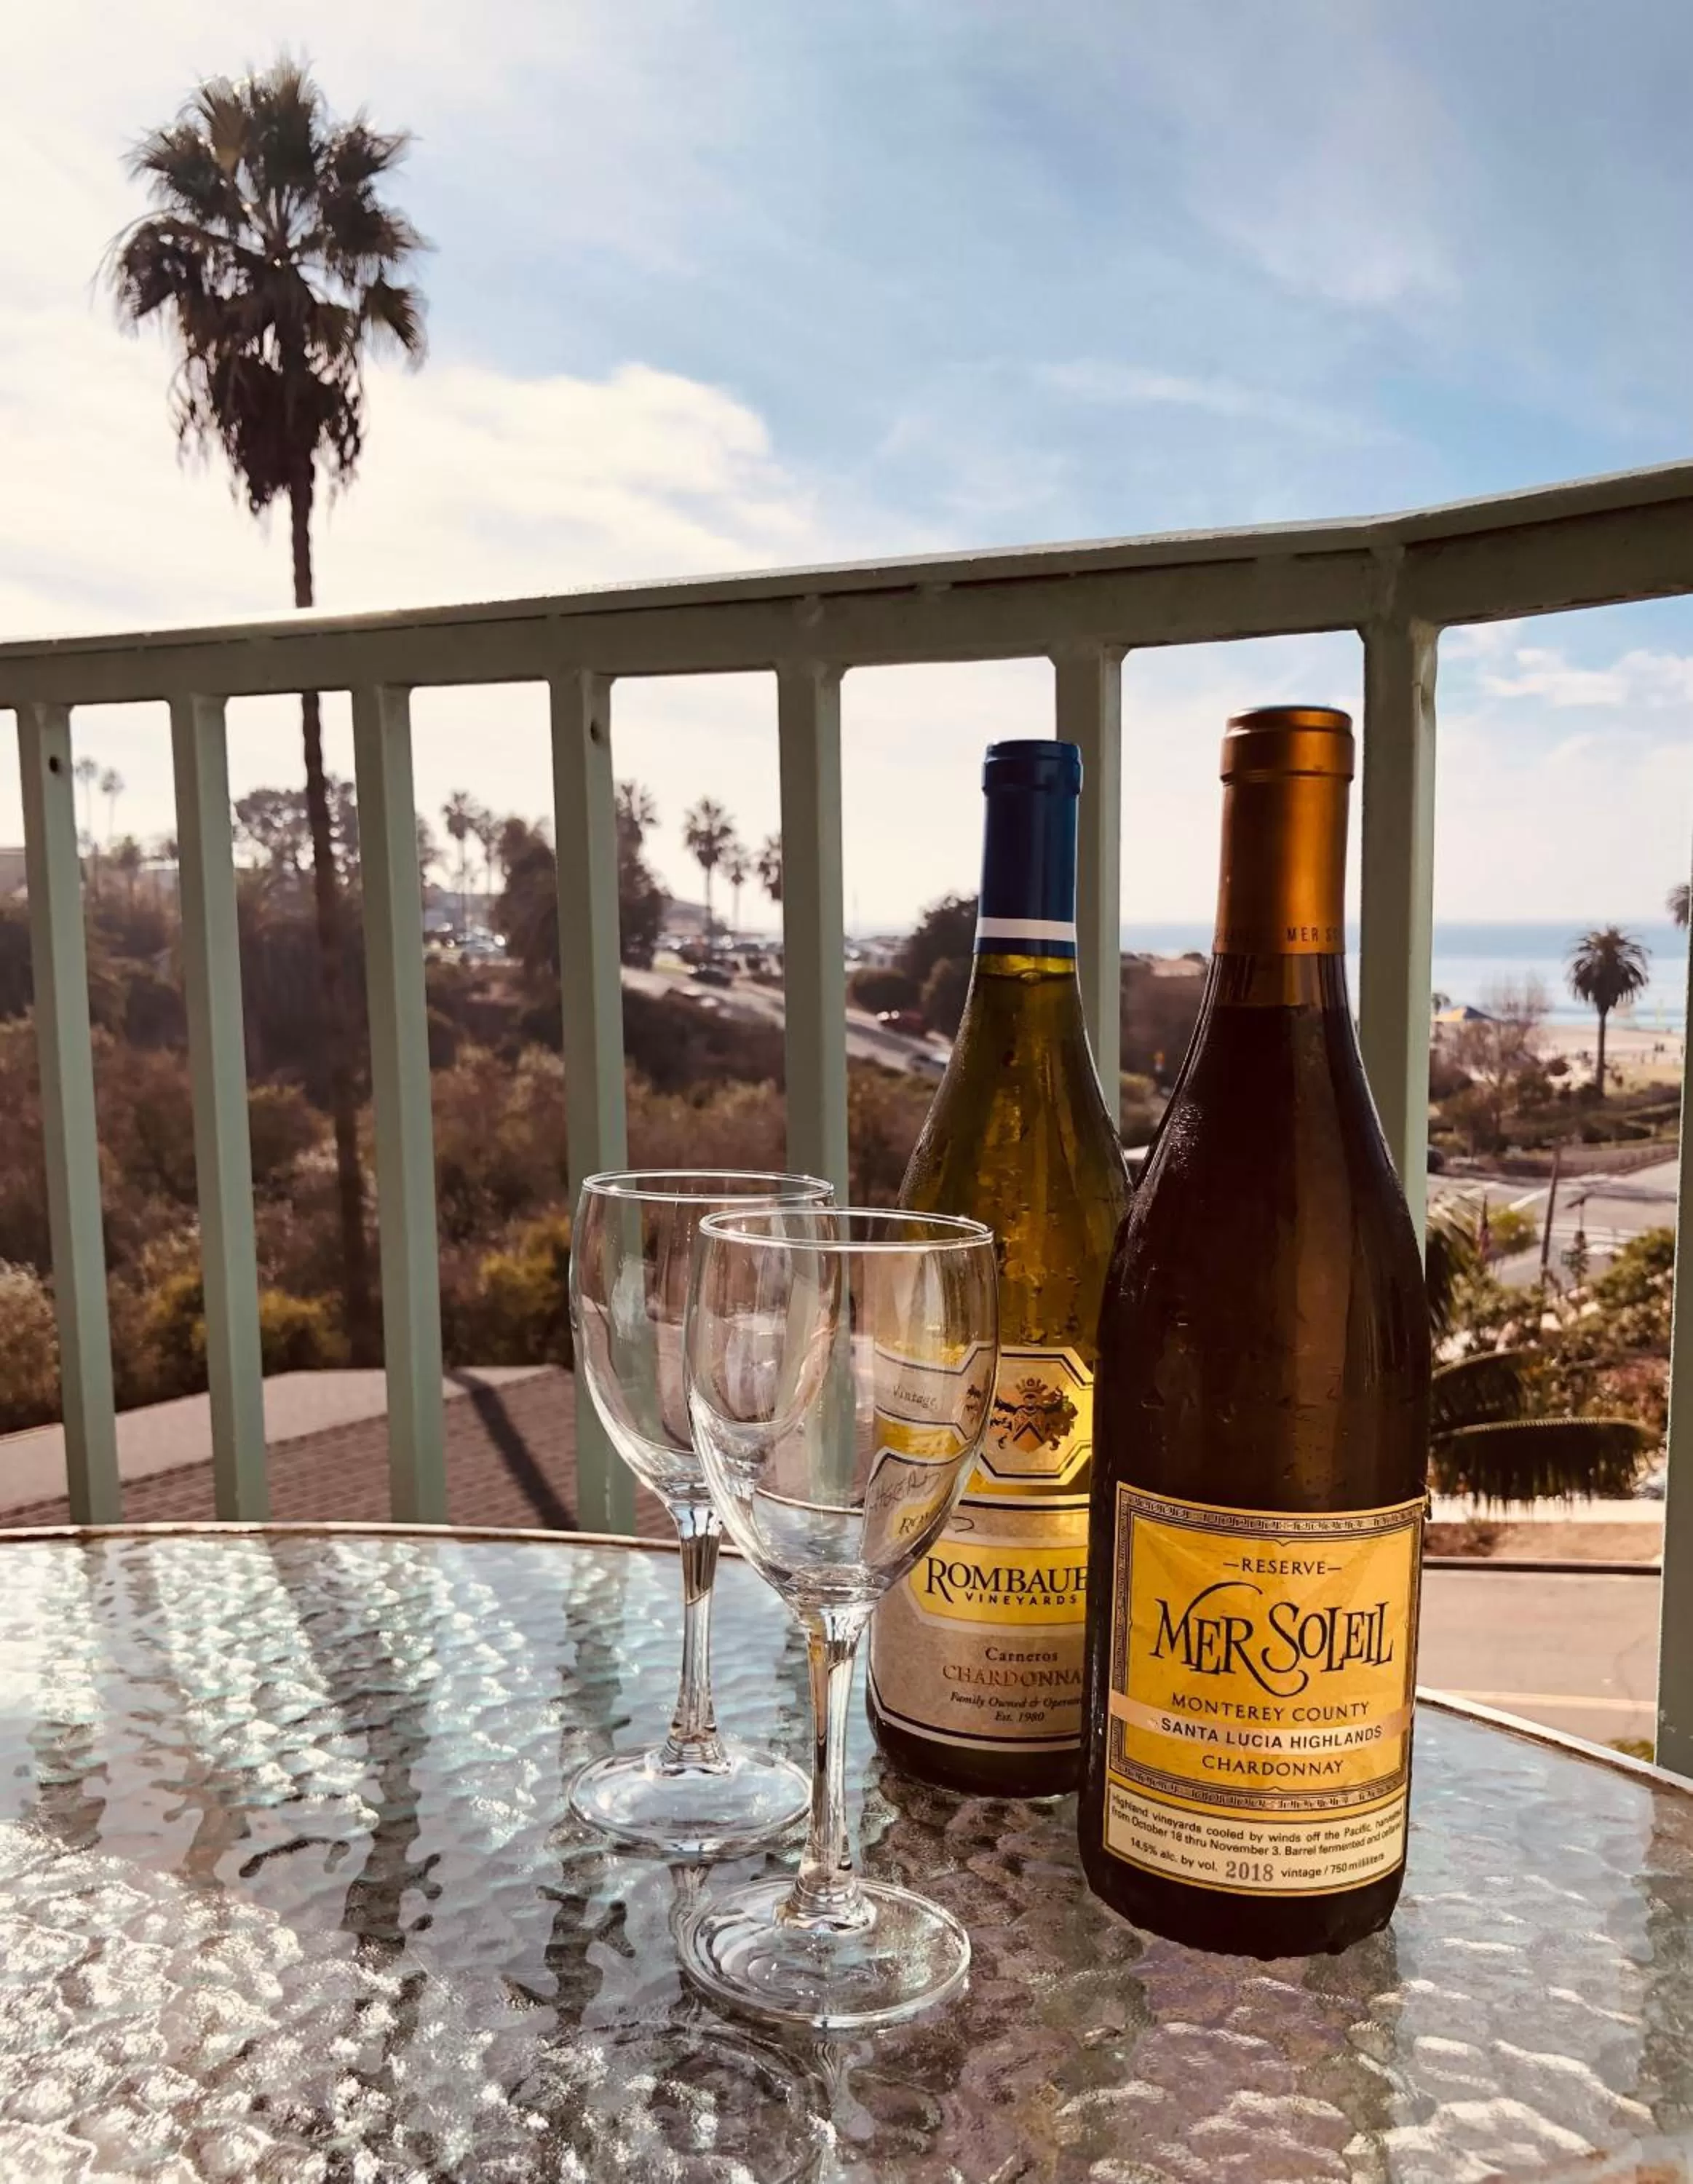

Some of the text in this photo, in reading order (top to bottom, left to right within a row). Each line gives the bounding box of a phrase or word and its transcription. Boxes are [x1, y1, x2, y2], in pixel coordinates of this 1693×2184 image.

[1287, 927, 1318, 942] MER
[924, 1556, 1086, 1603] ROMBAUE
[965, 1591, 1077, 1605] VINEYARDS
[1261, 1602, 1393, 1673] SOLEIL
[985, 1647, 1058, 1662] Carneros
[943, 1665, 1082, 1687] CHARDONNA
[950, 1691, 985, 1709] Family
[988, 1696, 1027, 1708] Owned
[1171, 1692, 1370, 1722] MONTEREY COUNTY
[1161, 1717, 1382, 1749] SANTA LUCIA HIGHLANDS
[1202, 1754, 1344, 1776] CHARDONNAY
[1132, 1815, 1167, 1837] October
[1170, 1829, 1183, 1842] 18
[1184, 1834, 1207, 1847] thru
[1210, 1839, 1269, 1856] November
[1272, 1845, 1281, 1856] 3.
[1285, 1845, 1316, 1856] Barrel
[1318, 1838, 1365, 1854] fermented
[1367, 1832, 1381, 1844] and
[1152, 1811, 1202, 1833] vineyards
[1206, 1827, 1244, 1840] cooled
[1249, 1831, 1264, 1843] by
[1269, 1832, 1301, 1843] winds
[1306, 1831, 1322, 1843] off
[1324, 1829, 1340, 1840] the
[1130, 1836, 1158, 1856] 14.5%
[1159, 1848, 1178, 1862] alc.
[1181, 1855, 1194, 1867] by
[1197, 1860, 1218, 1872] vol.
[1225, 1860, 1274, 1883] 2018
[1280, 1867, 1323, 1879] vintage
[1330, 1862, 1347, 1875] 750
